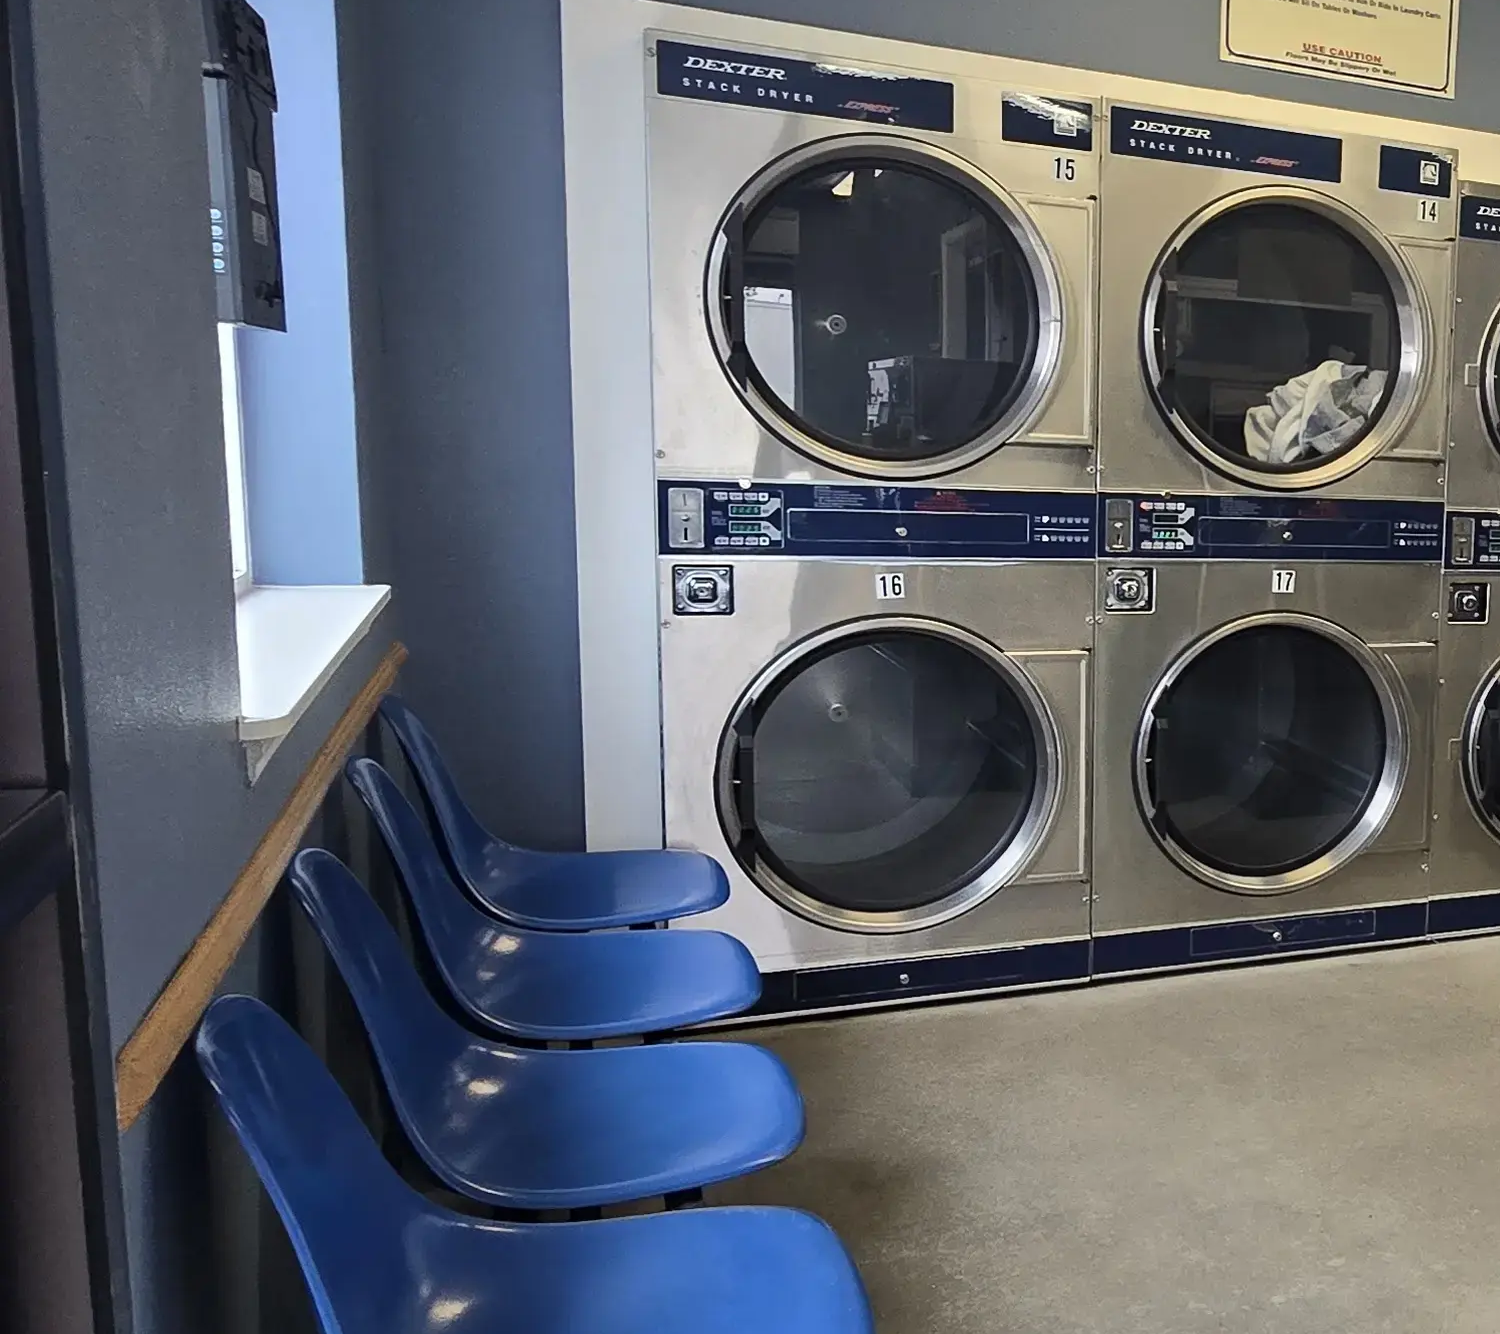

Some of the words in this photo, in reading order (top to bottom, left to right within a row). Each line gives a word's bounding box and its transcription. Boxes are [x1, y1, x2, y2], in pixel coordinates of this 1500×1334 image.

[1302, 43, 1325, 53] USE
[1329, 48, 1382, 63] CAUTION
[683, 56, 787, 81] DEXTER
[682, 77, 741, 94] STACK
[757, 87, 814, 104] DRYER
[1130, 120, 1212, 140] DEXTER
[1129, 138, 1176, 152] STACK
[1188, 146, 1232, 160] DRYER
[1053, 157, 1075, 181] 15
[1420, 200, 1437, 221] 14
[879, 575, 903, 598] 16
[1276, 571, 1295, 591] 17
